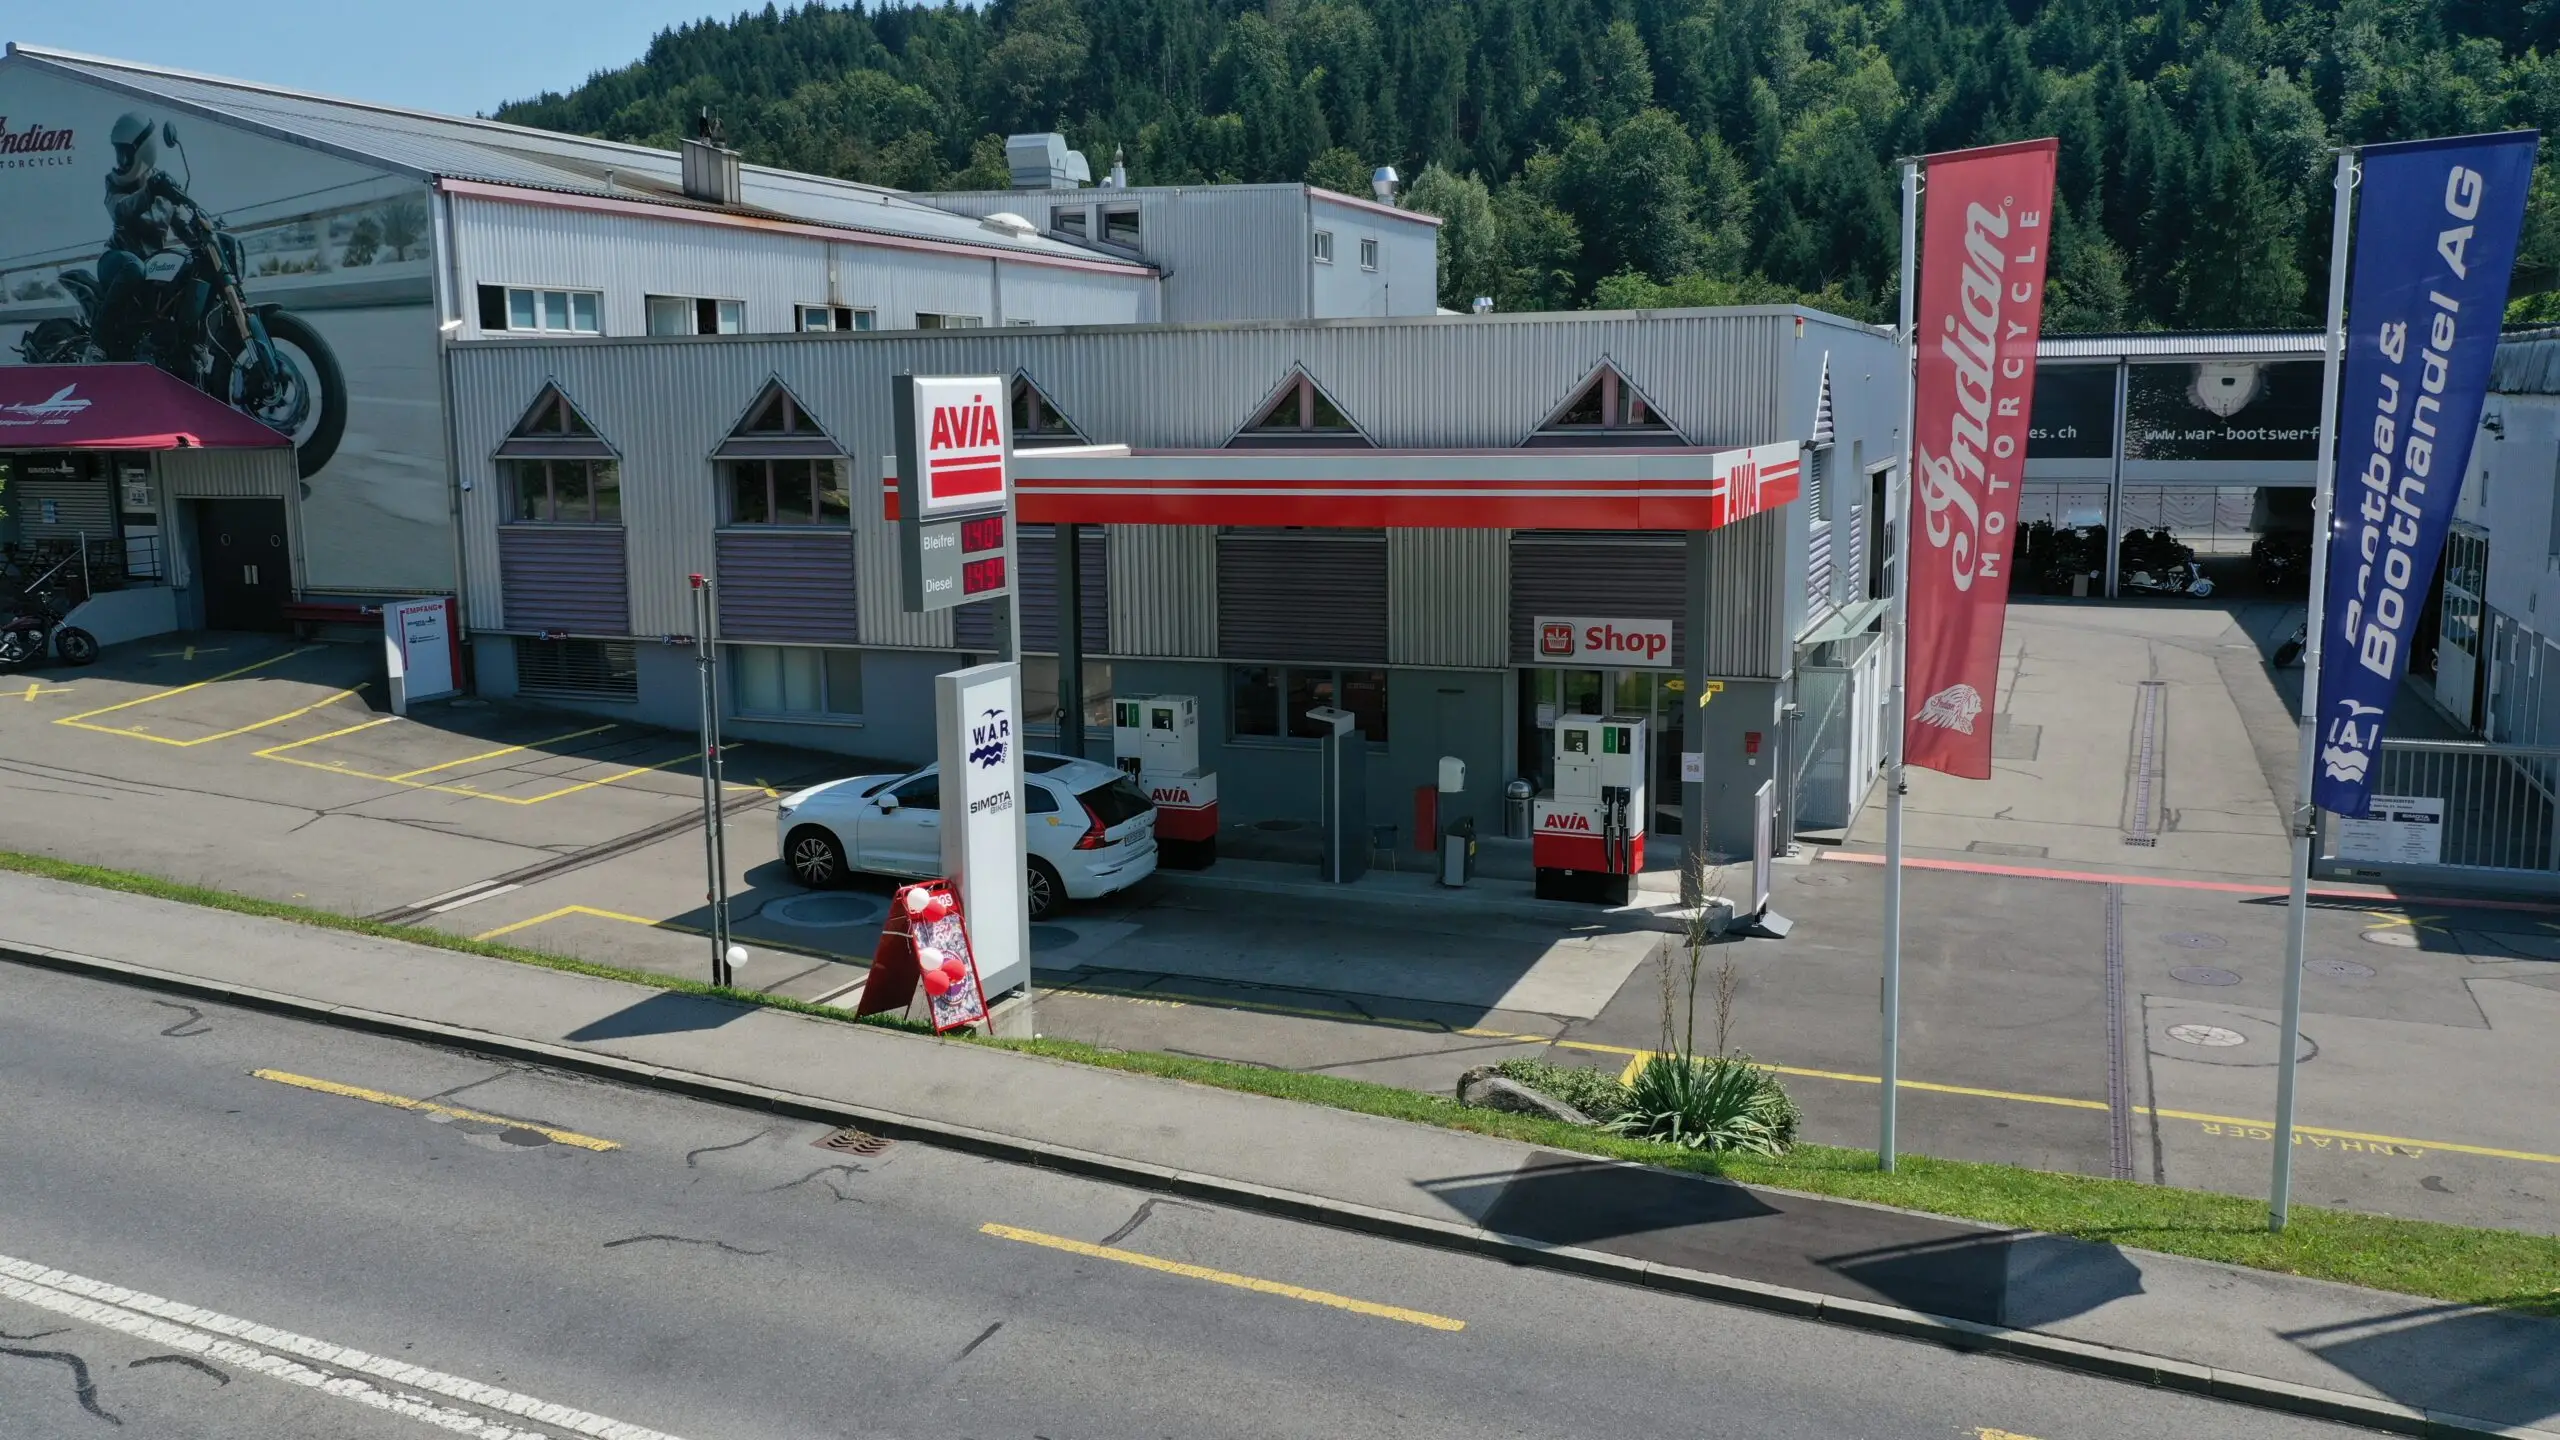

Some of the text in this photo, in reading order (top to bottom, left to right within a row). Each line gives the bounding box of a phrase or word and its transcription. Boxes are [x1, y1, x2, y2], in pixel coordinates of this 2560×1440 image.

[2380, 321, 2407, 364] &
[1919, 201, 2009, 592] Indian
[1979, 210, 2041, 578] MOTORCYCLE
[2359, 165, 2485, 680] Boothandel AG
[2145, 426, 2338, 441] www.war-bootswerf.
[923, 532, 955, 550] Bleifrei
[925, 576, 953, 593] Diesel
[405, 604, 438, 615] EMPFANG
[1585, 624, 1667, 660] Shop
[1163, 719, 1169, 728] 1
[1575, 741, 1584, 751] 3
[970, 791, 1011, 814] SIMOTA
[990, 800, 1012, 814] BIKES
